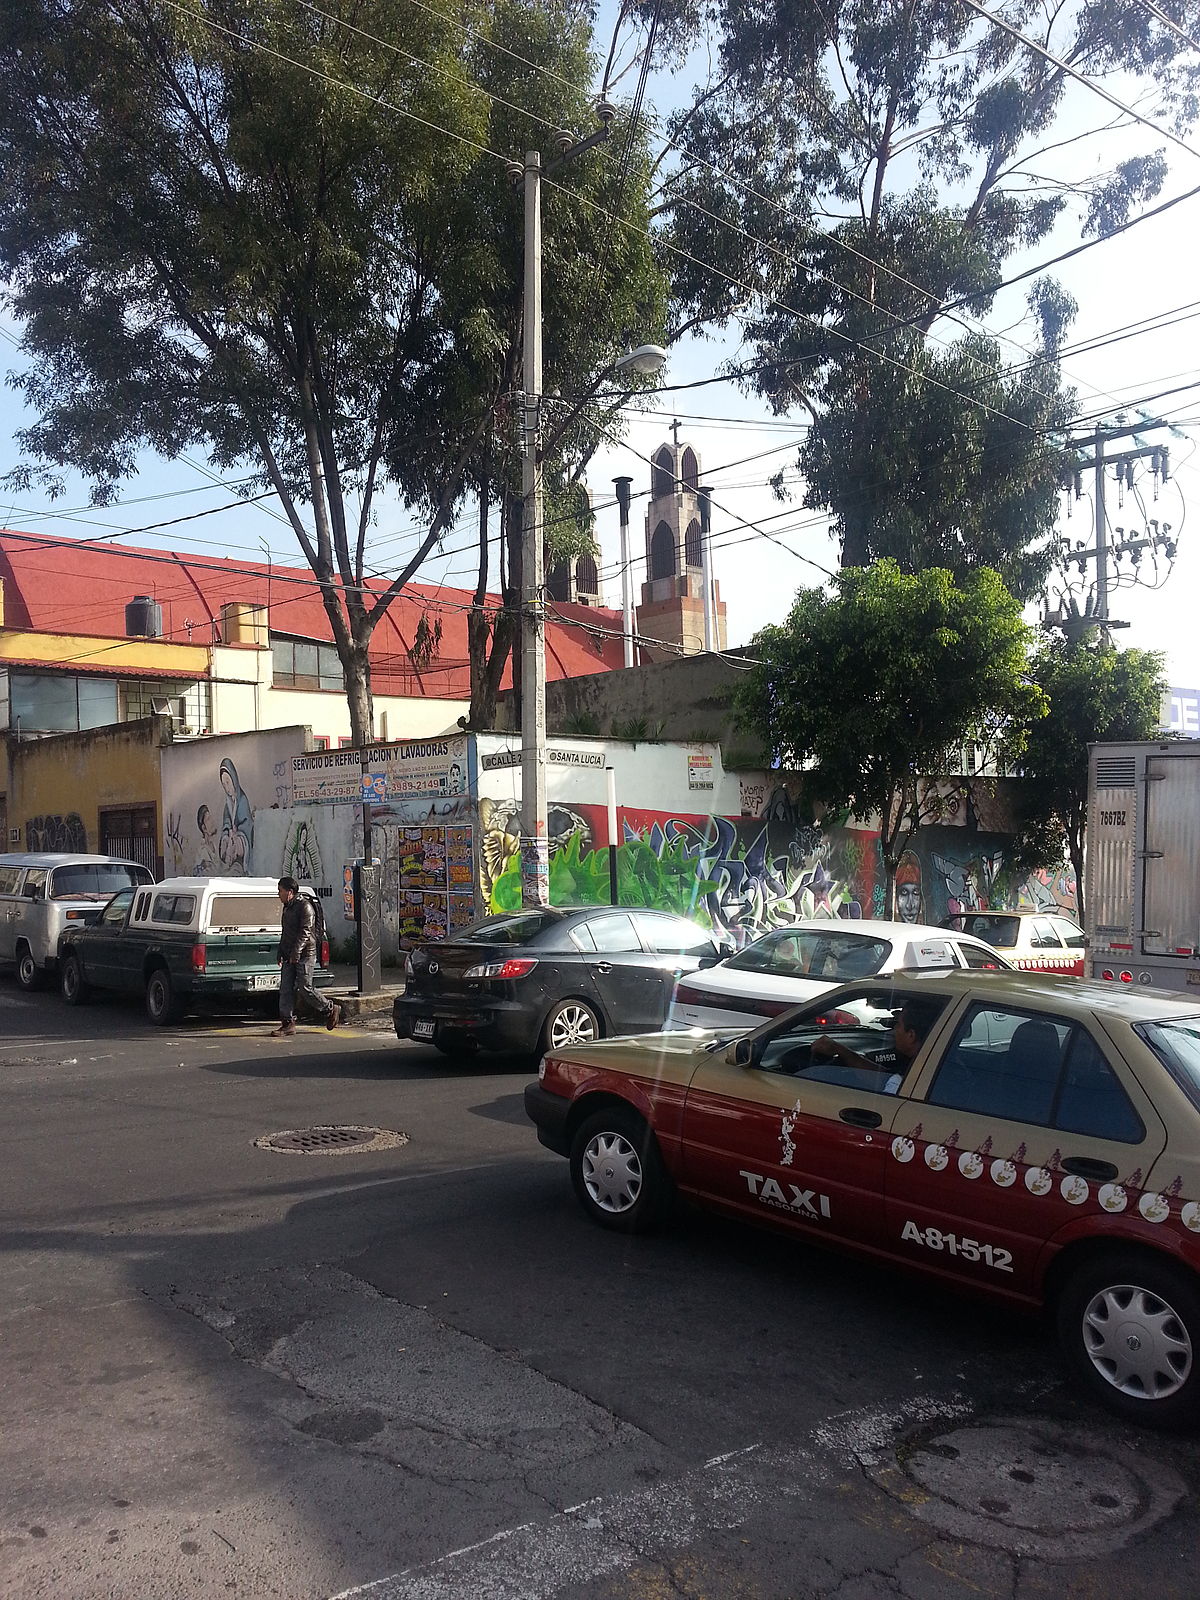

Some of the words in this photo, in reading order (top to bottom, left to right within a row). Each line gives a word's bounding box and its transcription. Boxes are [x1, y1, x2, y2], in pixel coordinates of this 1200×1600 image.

[293, 757, 322, 771] SERVICIO
[325, 754, 334, 767] DE
[335, 749, 391, 766] REFRIGACION
[394, 748, 399, 760] Y
[401, 742, 448, 759] LAVADORAS
[492, 756, 516, 766] CALLE
[557, 752, 580, 762] SANTA
[581, 755, 601, 765] LUCIA
[1101, 811, 1126, 825] 7667BZ
[740, 1170, 831, 1218] TAXI
[759, 1196, 819, 1221] GASOLINA
[901, 1220, 1014, 1273] A-81-512
